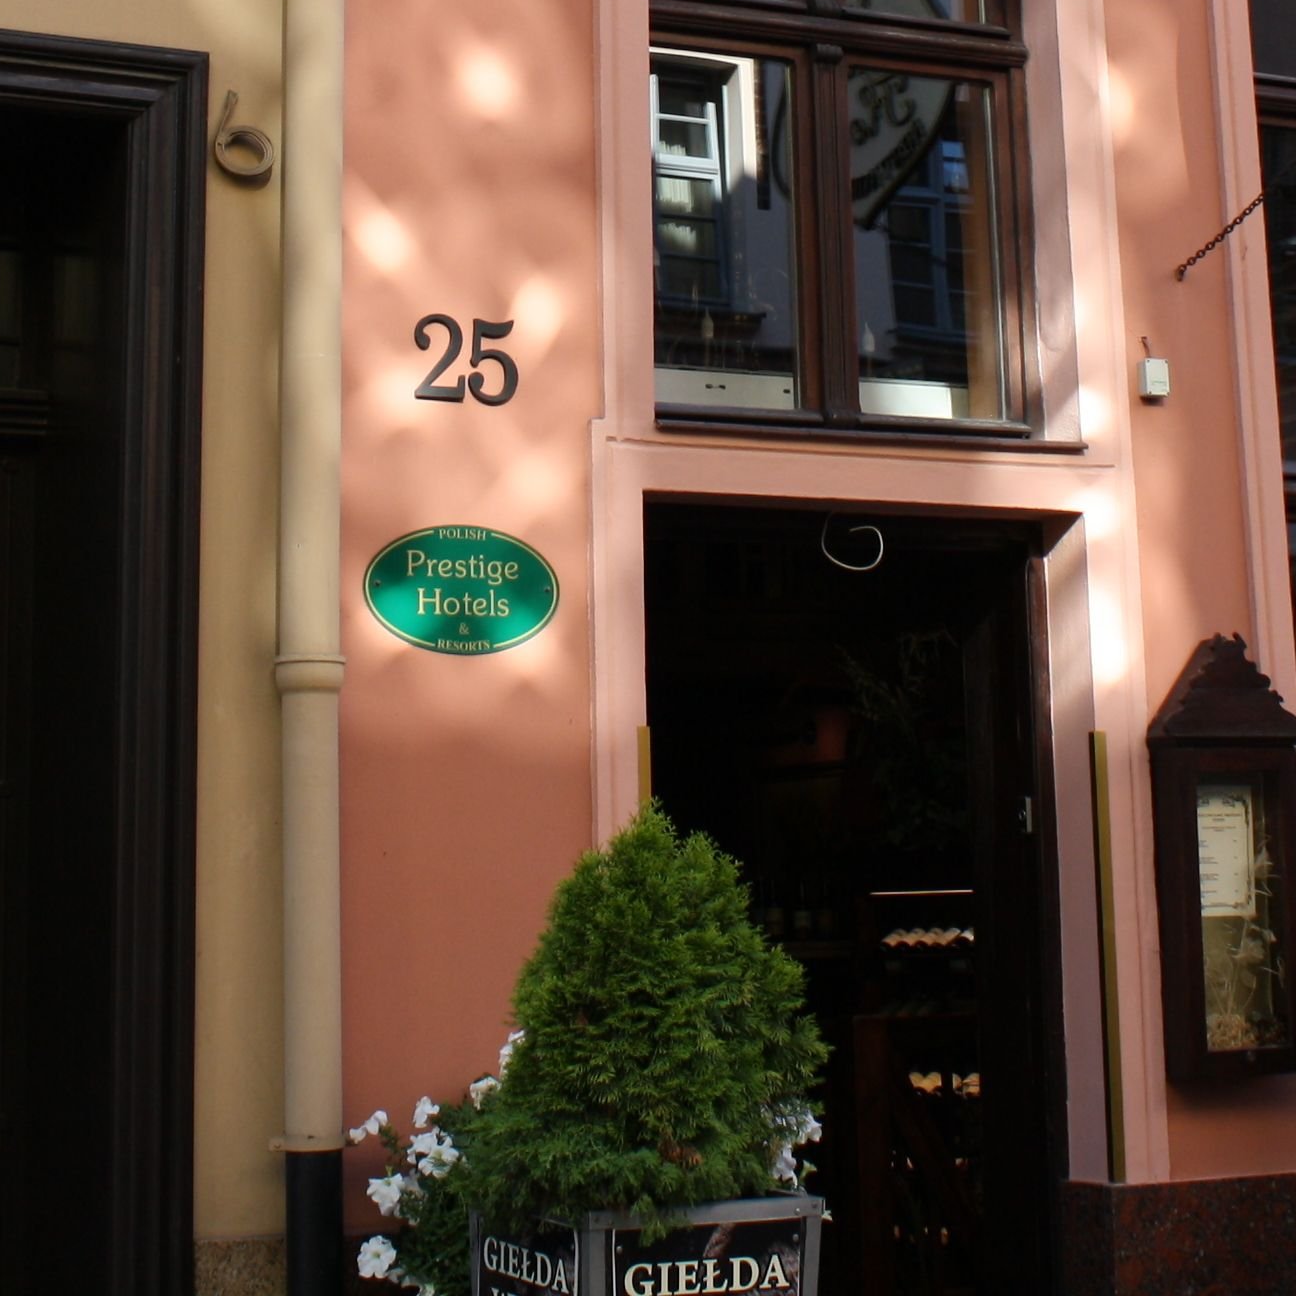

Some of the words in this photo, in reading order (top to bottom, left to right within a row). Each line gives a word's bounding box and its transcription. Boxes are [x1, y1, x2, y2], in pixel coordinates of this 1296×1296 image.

[414, 314, 519, 407] 25
[439, 528, 486, 541] POLISH
[406, 550, 519, 585] Prestige
[417, 587, 510, 617] Hotels
[437, 639, 490, 651] RESORTS
[459, 623, 469, 635] &
[483, 1237, 570, 1294] GIEŁDA
[624, 1254, 790, 1296] GIEŁDA
